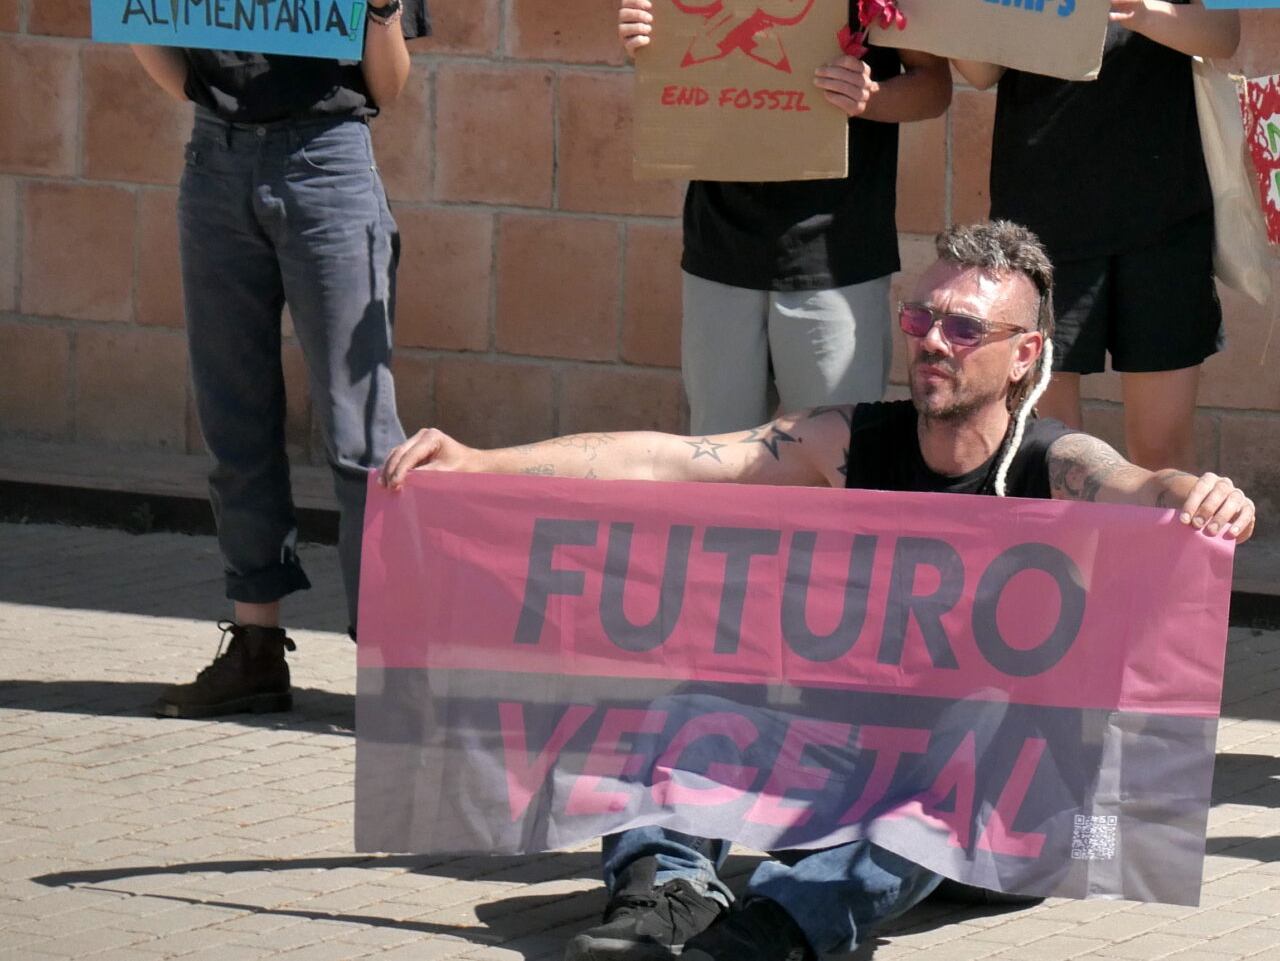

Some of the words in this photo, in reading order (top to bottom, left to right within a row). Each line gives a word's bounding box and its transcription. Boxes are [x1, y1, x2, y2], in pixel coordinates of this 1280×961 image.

[660, 85, 710, 107] END
[718, 87, 811, 112] FOSSIL
[514, 518, 1087, 677] FUTURO
[497, 701, 1048, 859] VEGETAL
